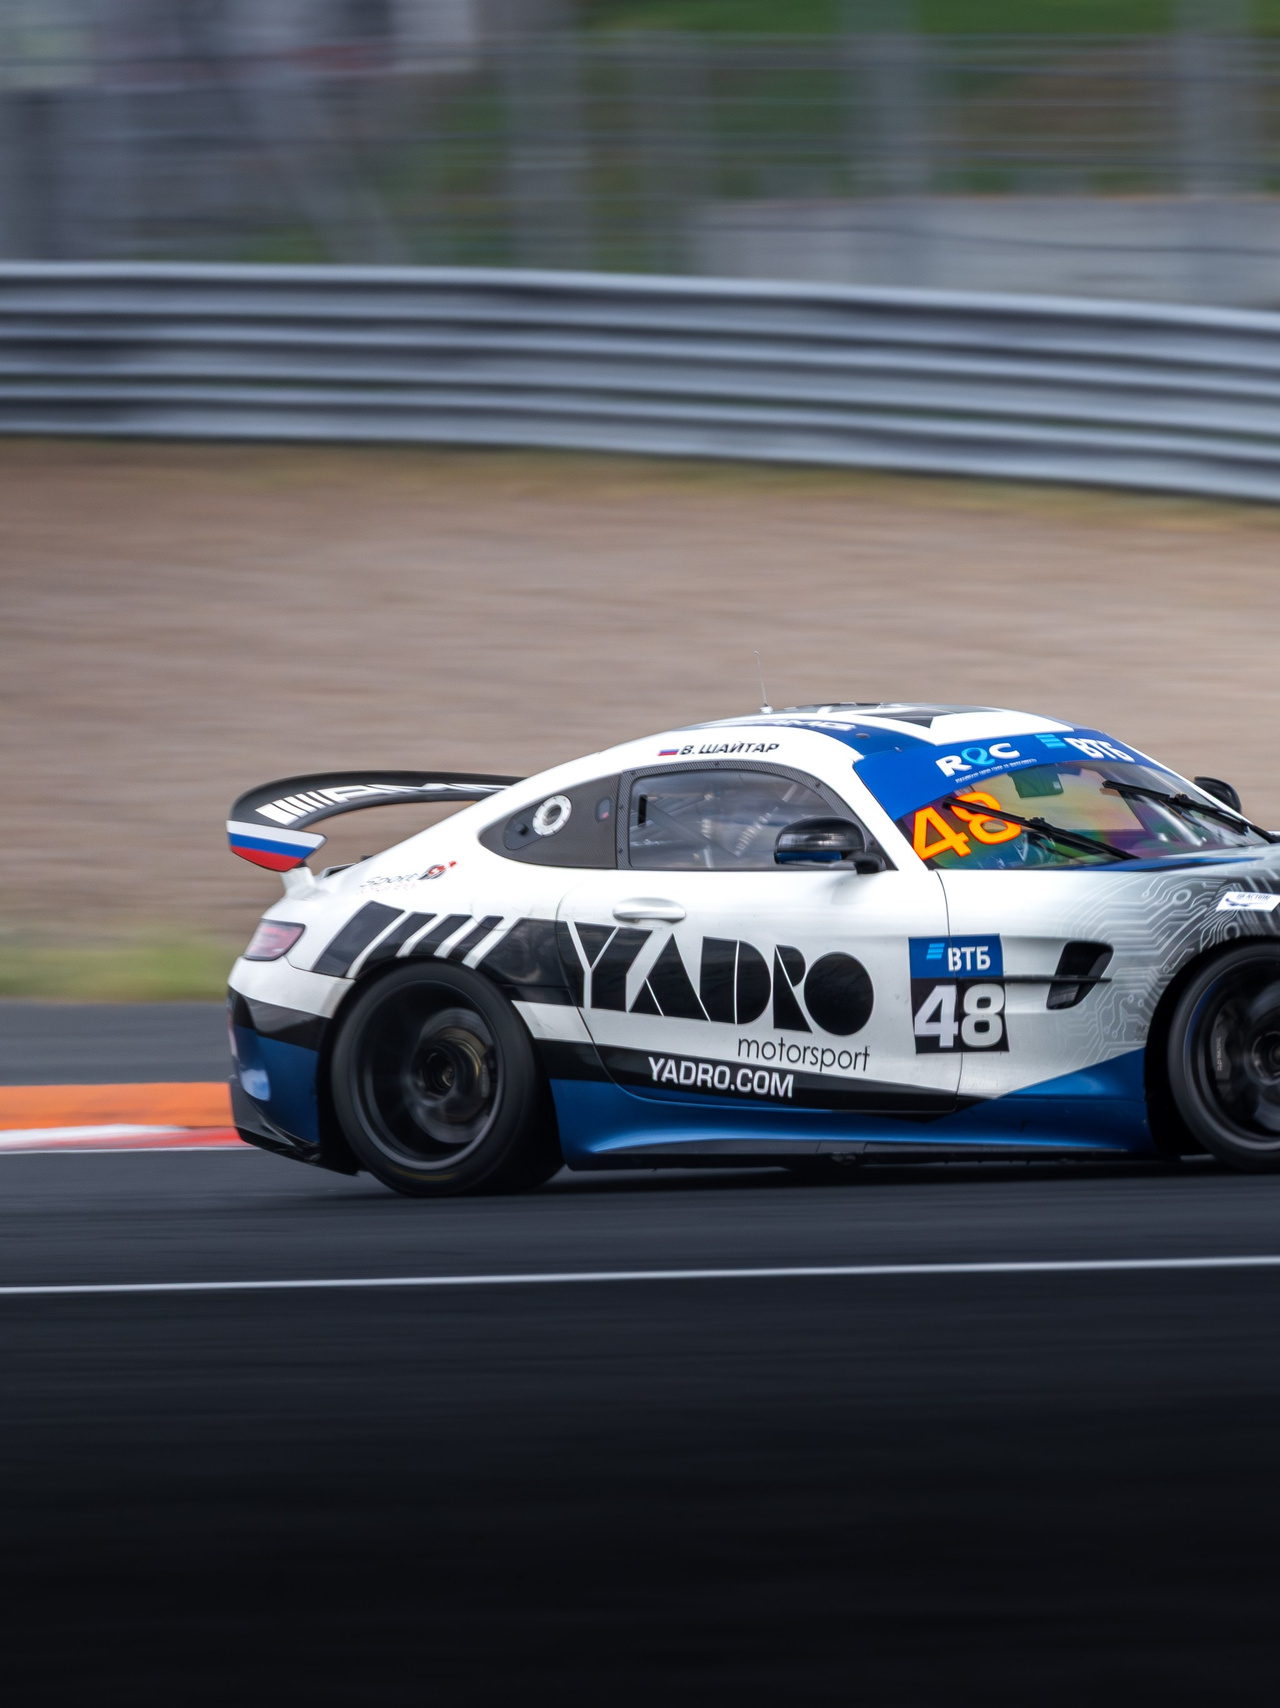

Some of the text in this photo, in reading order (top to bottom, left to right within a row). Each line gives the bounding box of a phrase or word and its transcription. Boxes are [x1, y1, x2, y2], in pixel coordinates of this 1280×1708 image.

[680, 741, 780, 756] В. ШАЙТАР
[1063, 737, 1135, 763] ВТБ
[912, 791, 1023, 861] 48
[572, 920, 876, 1037] YADRO
[947, 945, 992, 972] ВТБ
[913, 982, 1007, 1050] 48
[737, 1034, 871, 1073] motorsport
[647, 1056, 795, 1099] YADRO.COM
